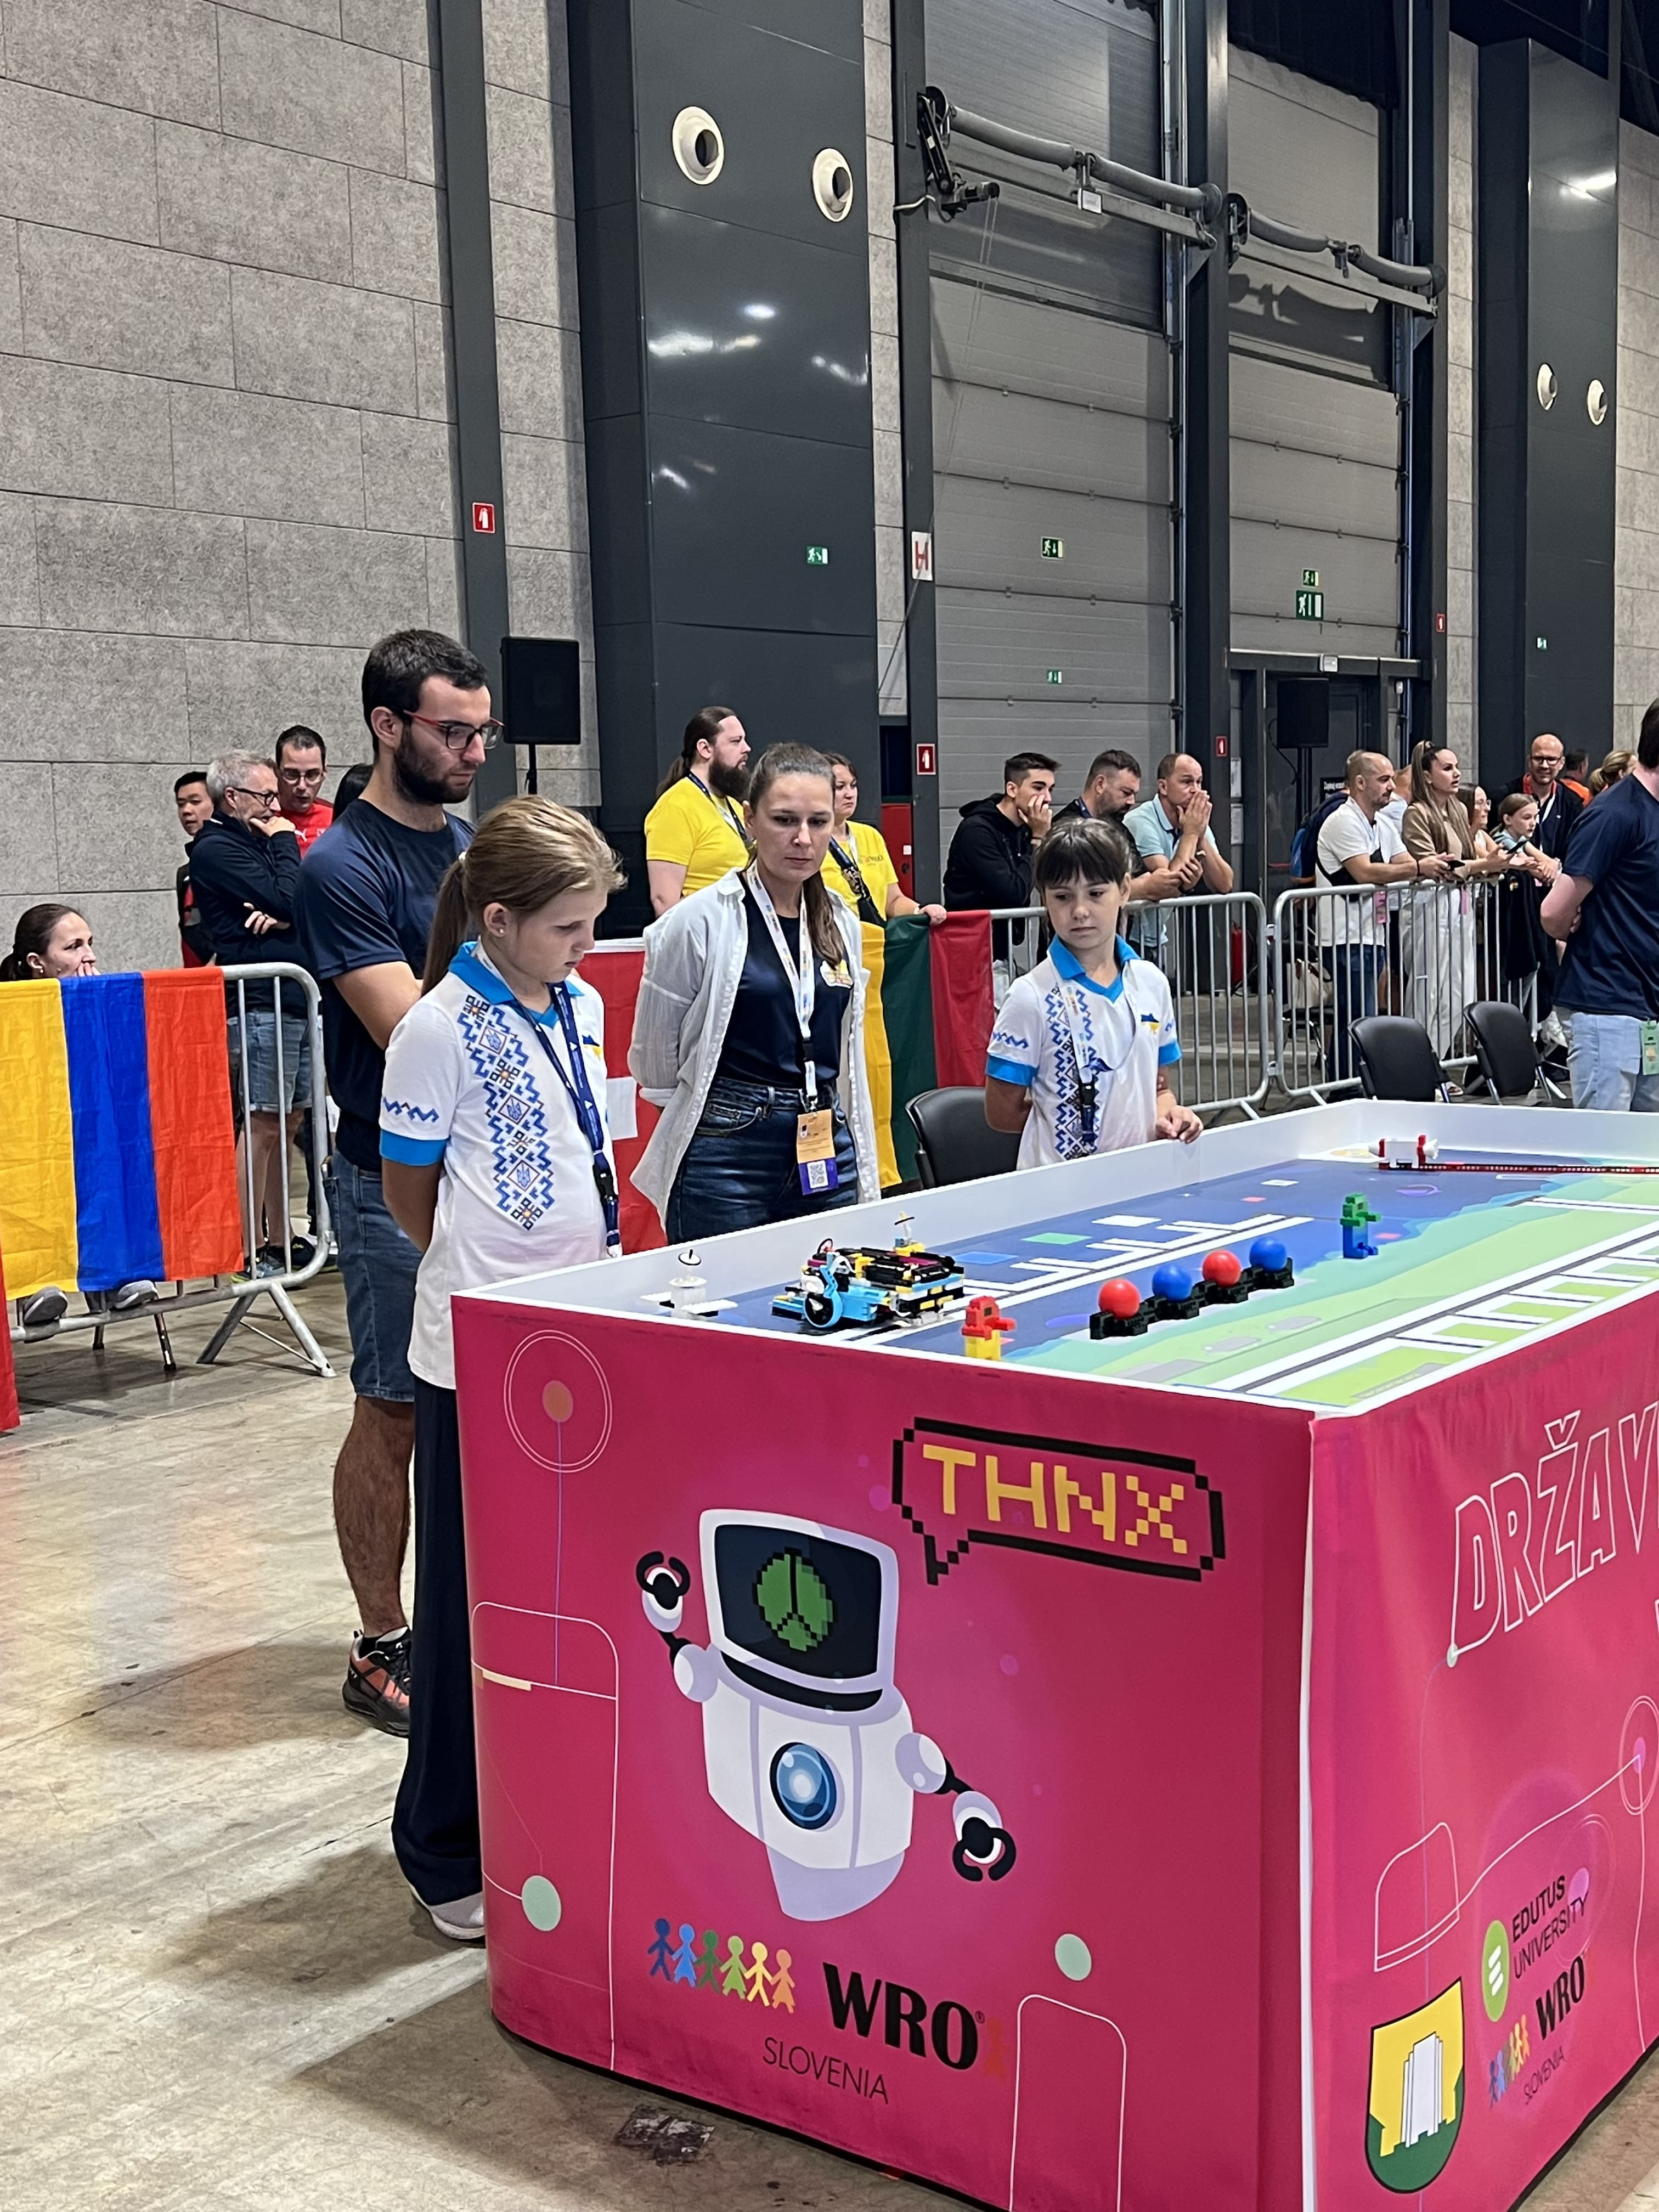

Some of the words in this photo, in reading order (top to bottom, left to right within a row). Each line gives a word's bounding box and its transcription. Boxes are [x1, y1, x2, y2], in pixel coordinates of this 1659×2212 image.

[915, 541, 929, 571] H
[923, 1444, 1187, 1554] THNX
[1449, 1401, 1659, 1659] DRŽAV
[1513, 1875, 1565, 1943] EDUTUS
[1514, 1891, 1589, 1979] UNIVERSITY
[1536, 1955, 1585, 2041] WRO
[763, 2036, 889, 2105] SLOVENIA
[1523, 2046, 1566, 2106] SLOVENIA
